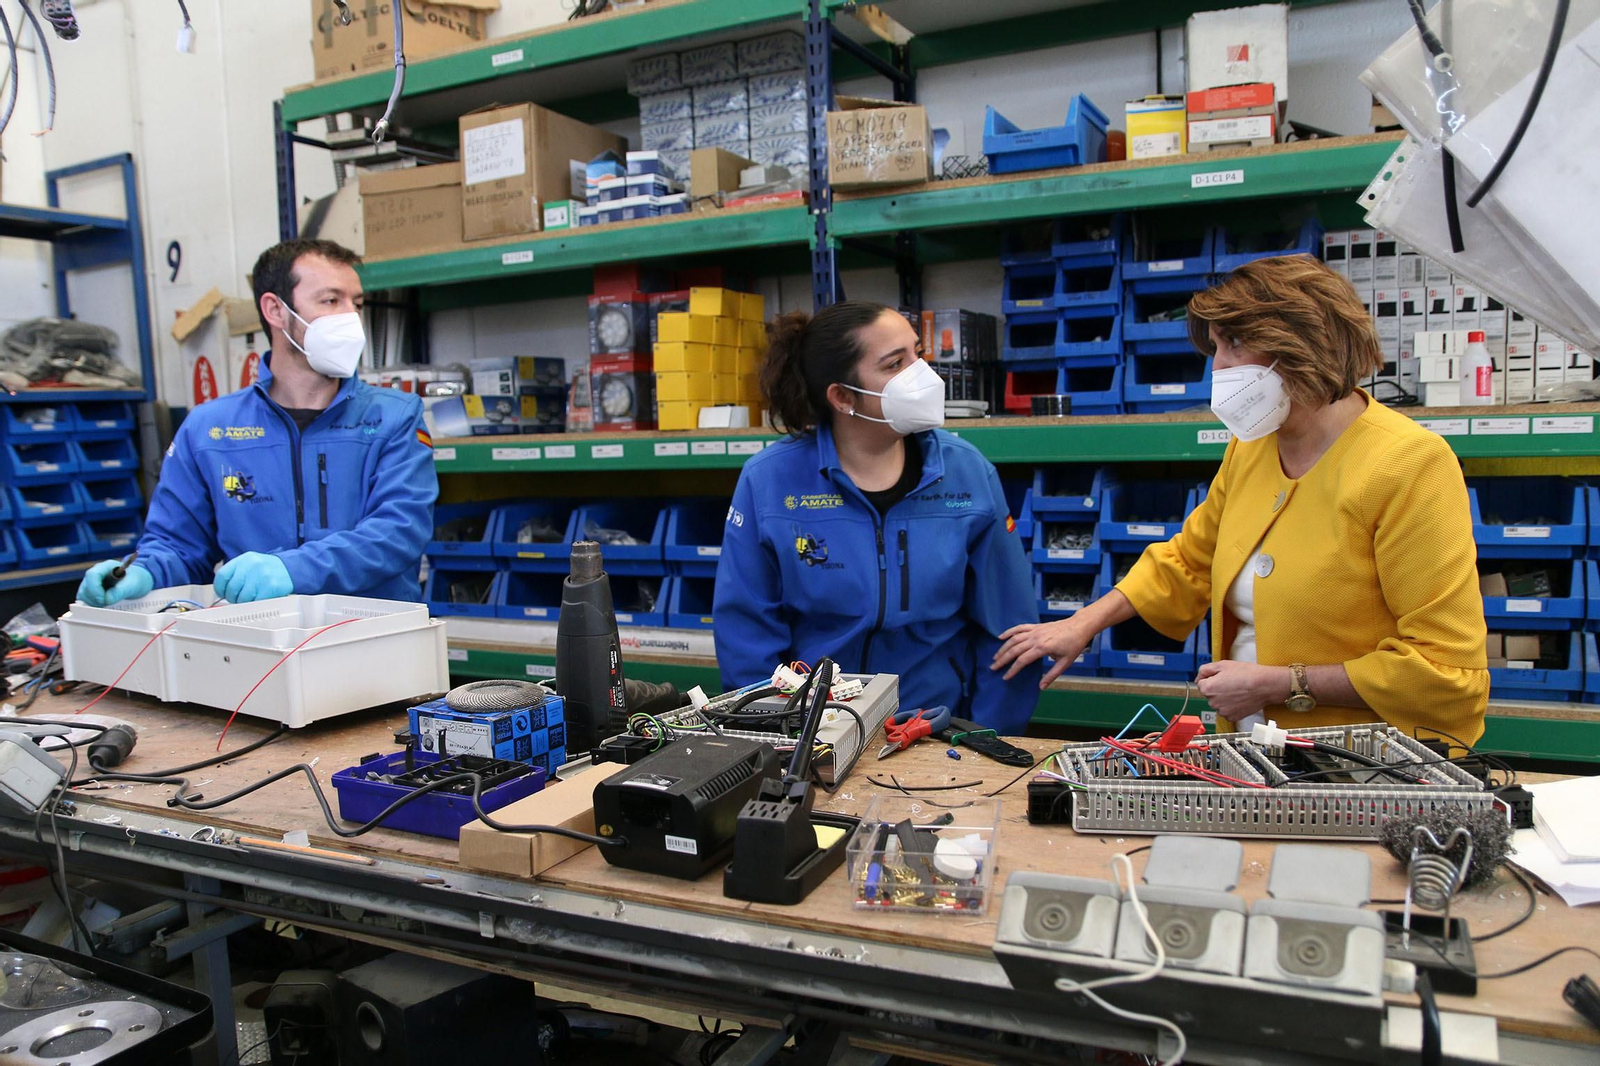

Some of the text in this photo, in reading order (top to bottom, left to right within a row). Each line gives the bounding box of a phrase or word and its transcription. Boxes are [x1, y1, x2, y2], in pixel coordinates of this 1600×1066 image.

[1195, 173, 1236, 184] D-1 C1 P4
[166, 240, 182, 283] 9
